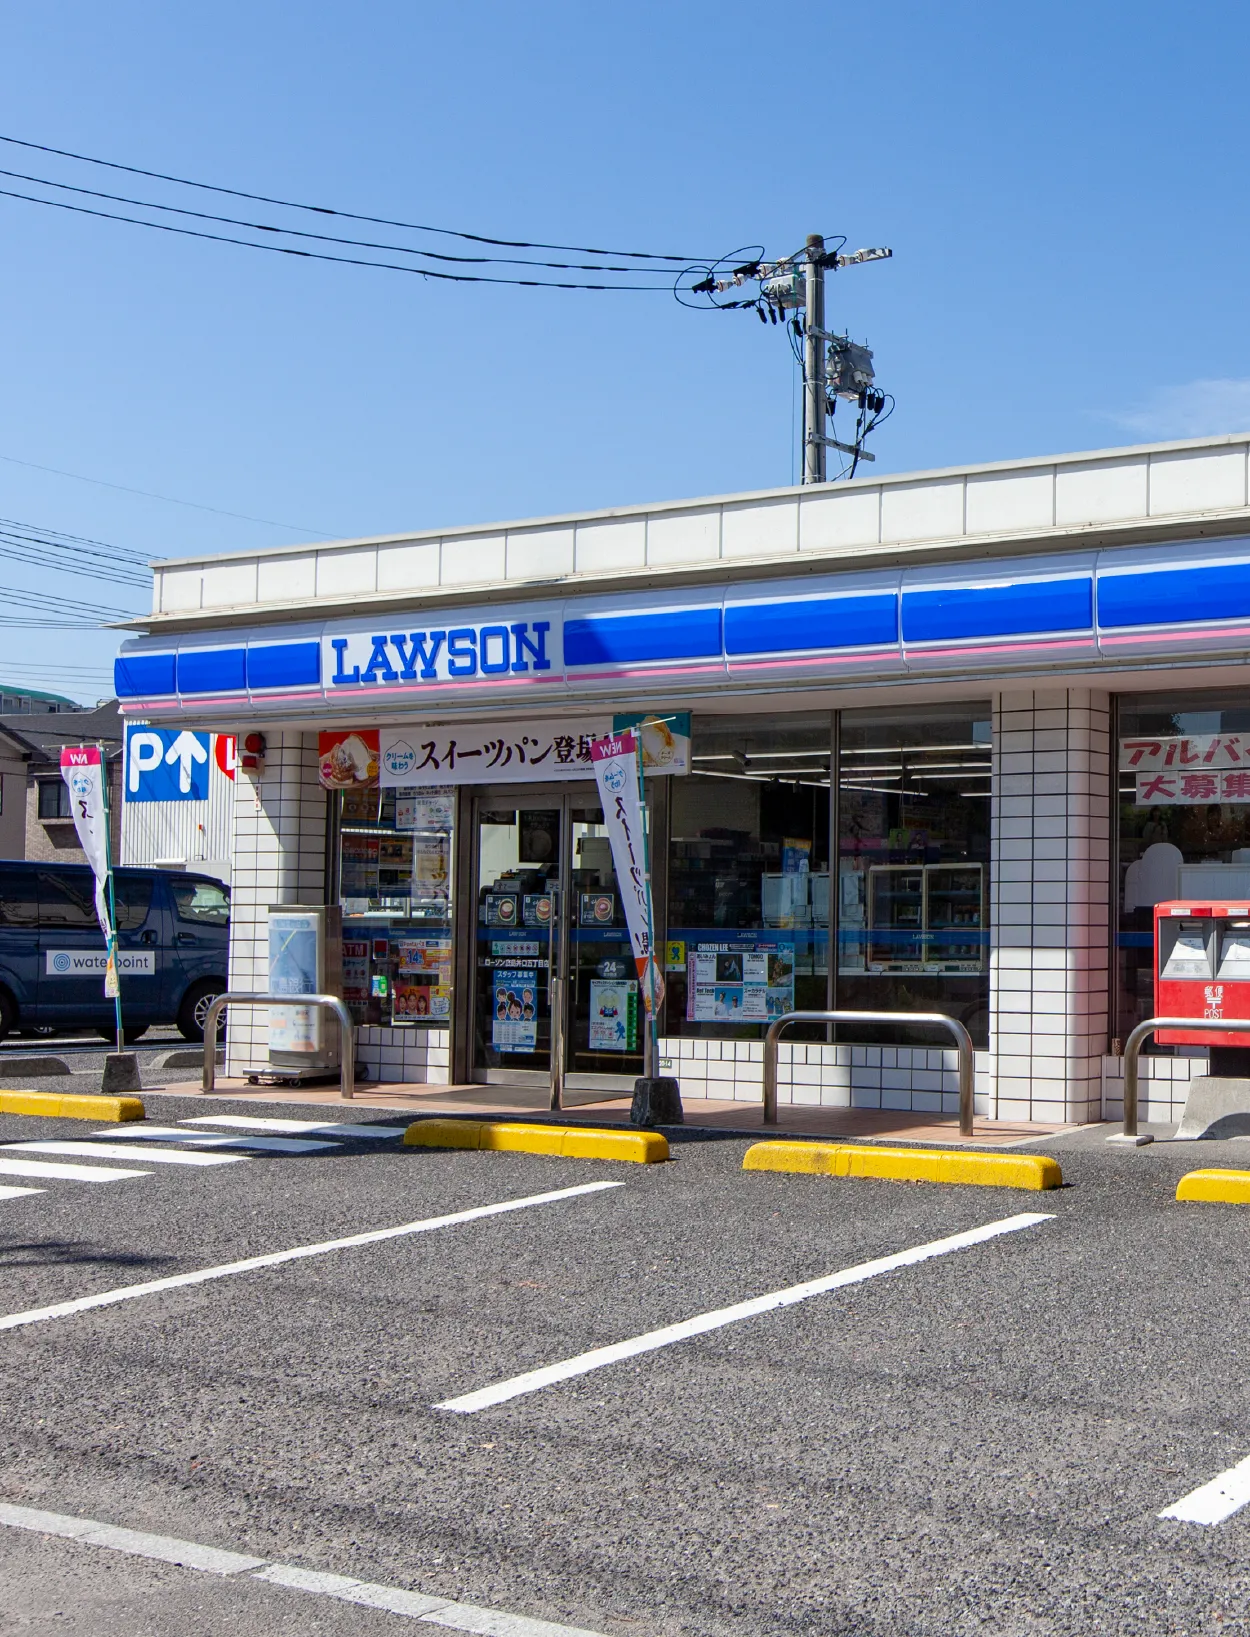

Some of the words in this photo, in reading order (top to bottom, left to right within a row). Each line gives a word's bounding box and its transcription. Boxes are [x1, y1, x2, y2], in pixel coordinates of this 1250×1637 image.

[331, 621, 551, 684] LAWSON
[385, 751, 414, 761] クリームを
[416, 732, 613, 771] スイーツパン登場
[129, 732, 164, 793] P
[391, 761, 409, 771] 味わう
[73, 956, 149, 968] wateoint
[603, 961, 617, 973] 24
[497, 971, 535, 979] スタッフ募集中
[1204, 985, 1224, 998] 郵便
[1204, 1009, 1223, 1019] POST
